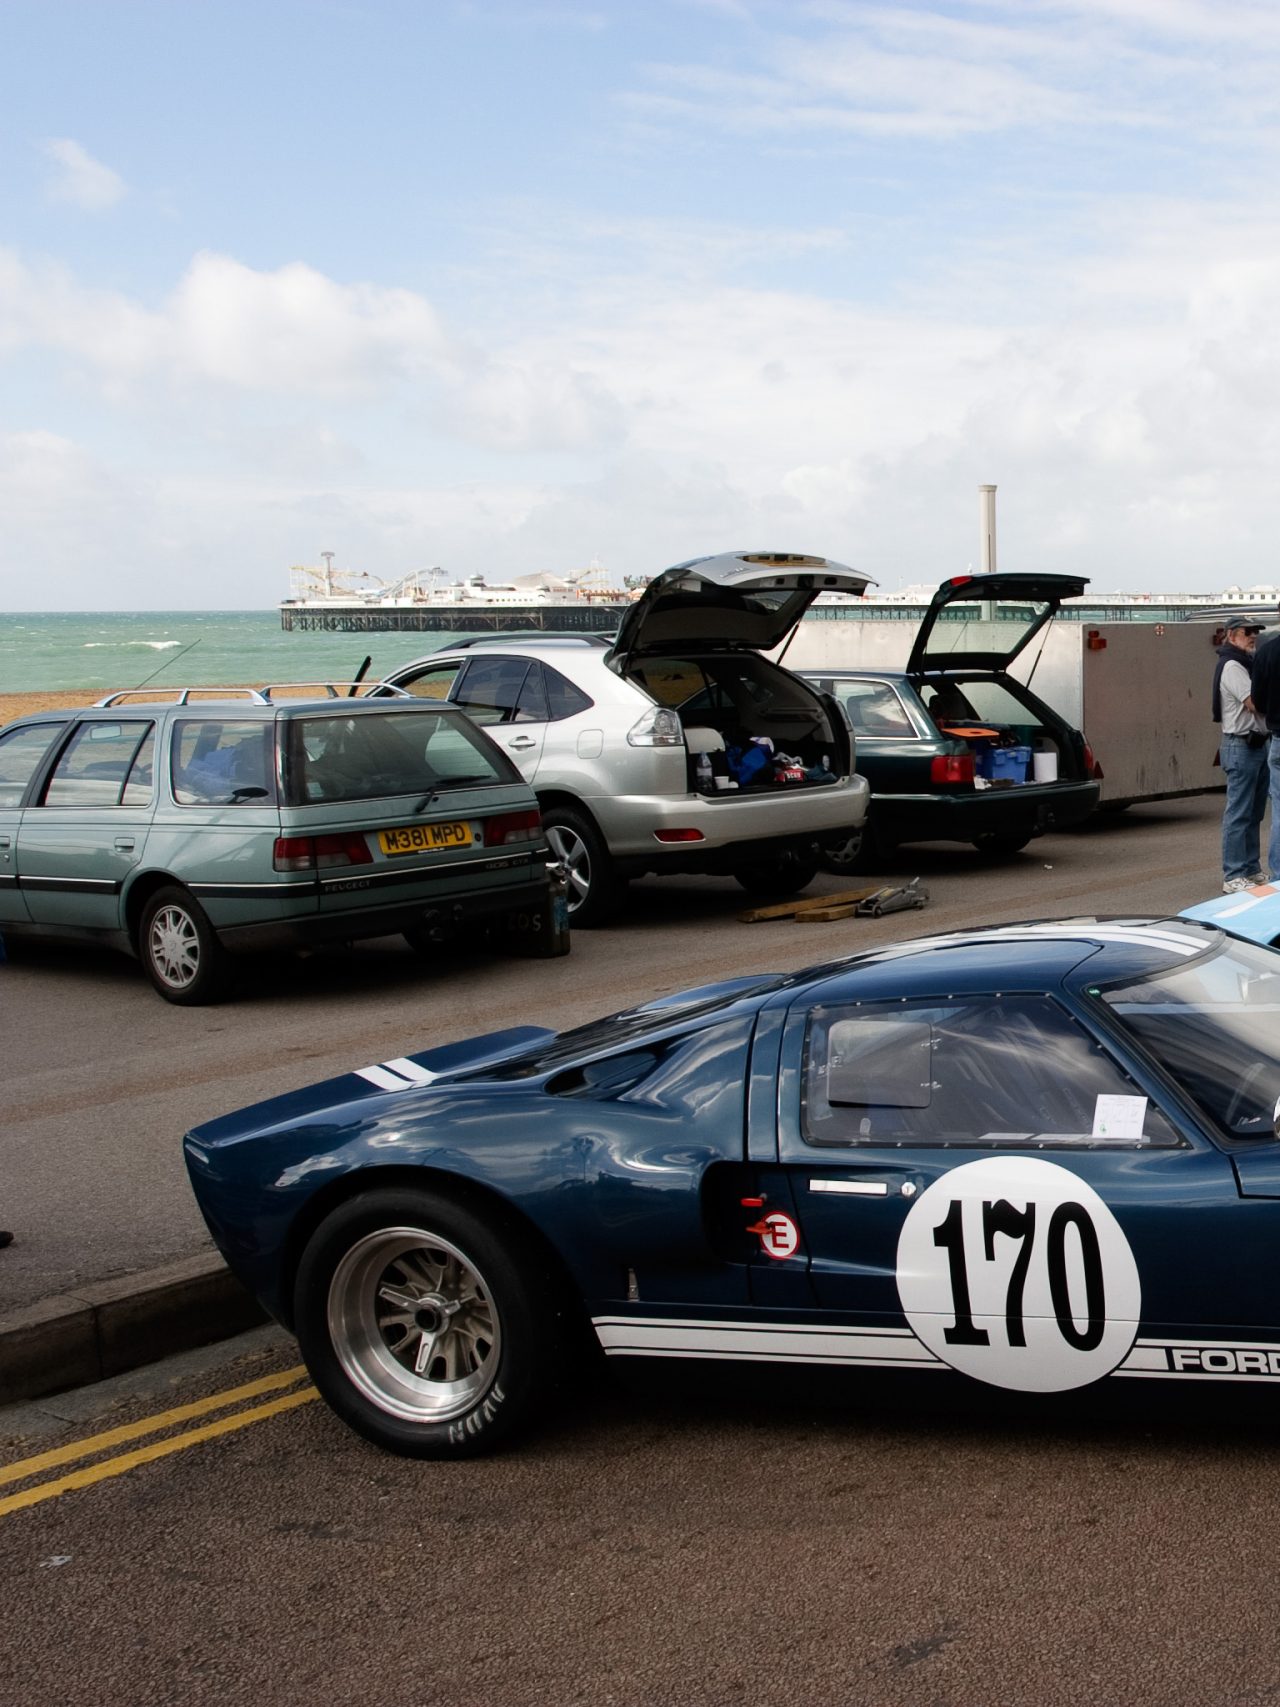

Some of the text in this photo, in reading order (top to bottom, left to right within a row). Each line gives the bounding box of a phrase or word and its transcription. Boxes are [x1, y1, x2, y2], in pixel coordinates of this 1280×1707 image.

[384, 824, 466, 851] M381 MPD
[770, 1221, 790, 1249] E
[932, 1198, 1106, 1351] 170
